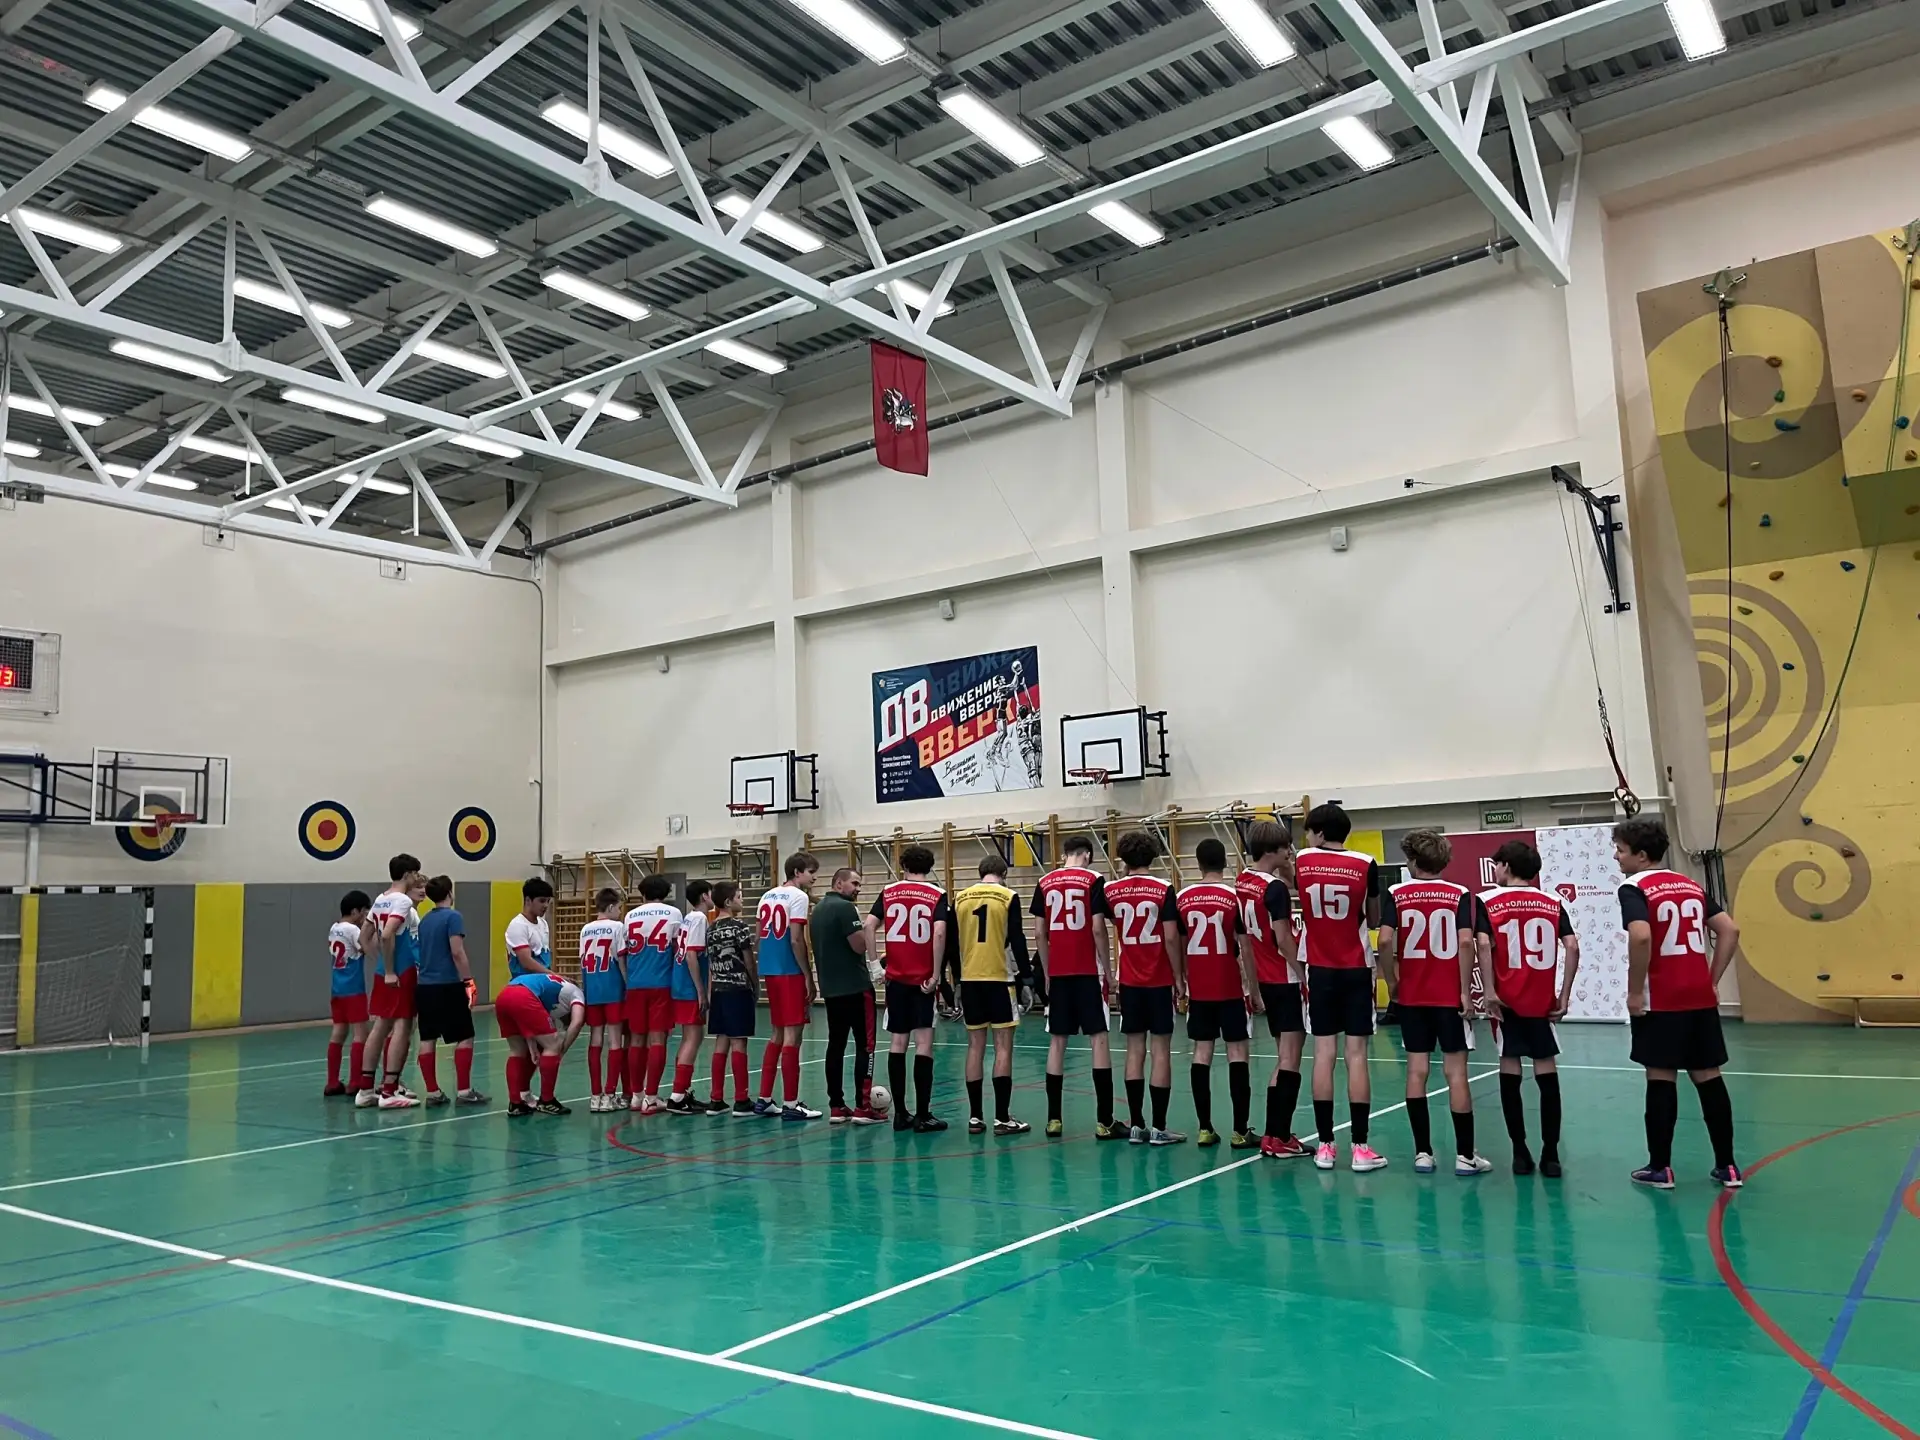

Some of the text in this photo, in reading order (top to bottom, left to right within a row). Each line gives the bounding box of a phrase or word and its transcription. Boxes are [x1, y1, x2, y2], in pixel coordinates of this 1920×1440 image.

[0, 669, 13, 686] 3
[878, 679, 929, 752] ДВ
[930, 675, 999, 724] ДВИЖЕНИЕ
[1487, 814, 1513, 822] ВЫХОД
[629, 909, 671, 919] ЕДИНСТВО
[759, 903, 787, 940] 20
[1046, 889, 1086, 930] 25
[1305, 883, 1349, 920] 15
[628, 919, 669, 955] 54
[886, 903, 931, 944] 26
[972, 903, 988, 943] 1
[1114, 901, 1161, 945] 22
[1187, 911, 1228, 955] 21
[1401, 909, 1458, 960] 20
[1657, 899, 1705, 956] 23
[581, 939, 613, 973] 47
[1498, 917, 1556, 971] 19
